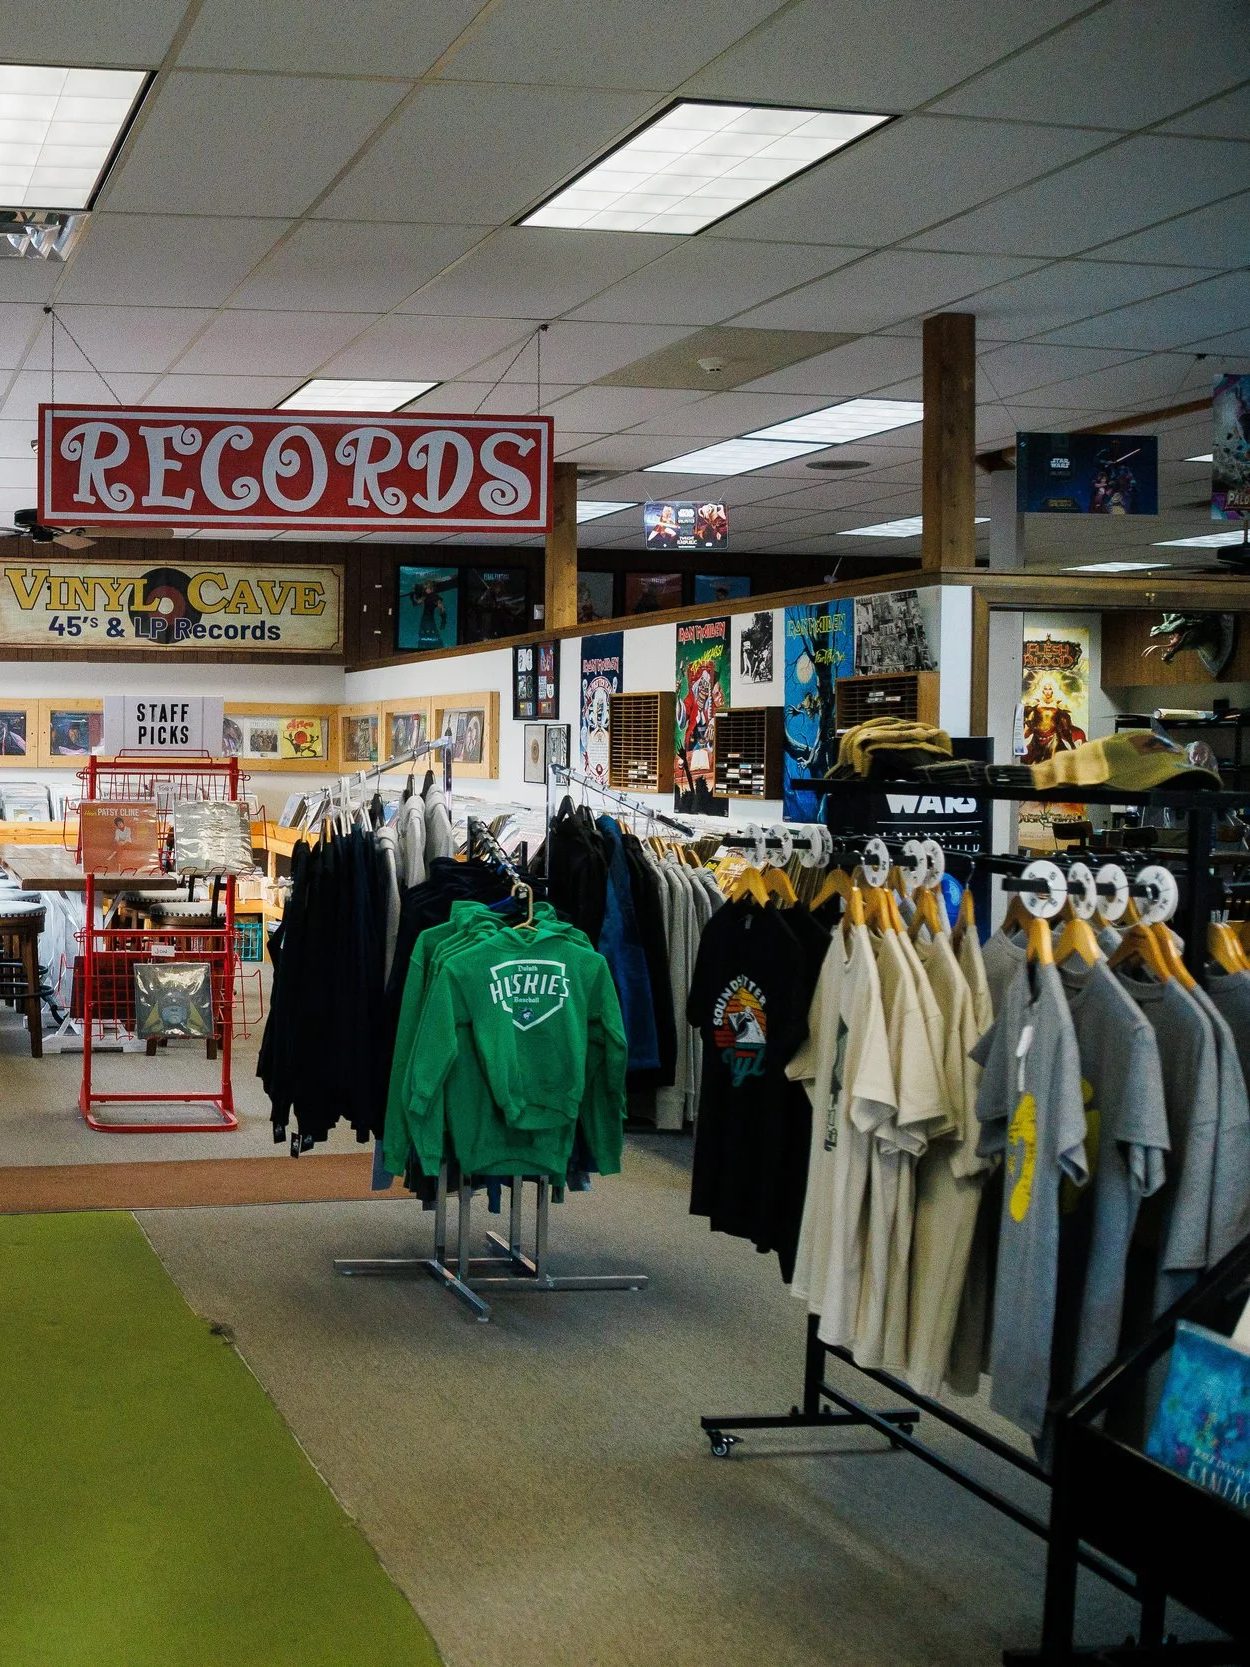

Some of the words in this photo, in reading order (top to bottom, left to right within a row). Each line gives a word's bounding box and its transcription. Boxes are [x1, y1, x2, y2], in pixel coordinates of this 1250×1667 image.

[60, 421, 537, 516] RECORDS
[4, 567, 162, 612] VINYL
[187, 572, 327, 616] CAVE
[48, 615, 99, 638] 45's
[106, 616, 125, 638] &
[134, 617, 167, 640] LP
[174, 617, 282, 641] Records
[1026, 643, 1070, 656] FLESH
[1022, 654, 1075, 668] BLOOD
[136, 702, 190, 723] STAFF
[137, 725, 190, 746] PICKS
[97, 807, 120, 817] PATSY
[121, 808, 140, 817] CLINE
[513, 996, 540, 1004] Baseball
